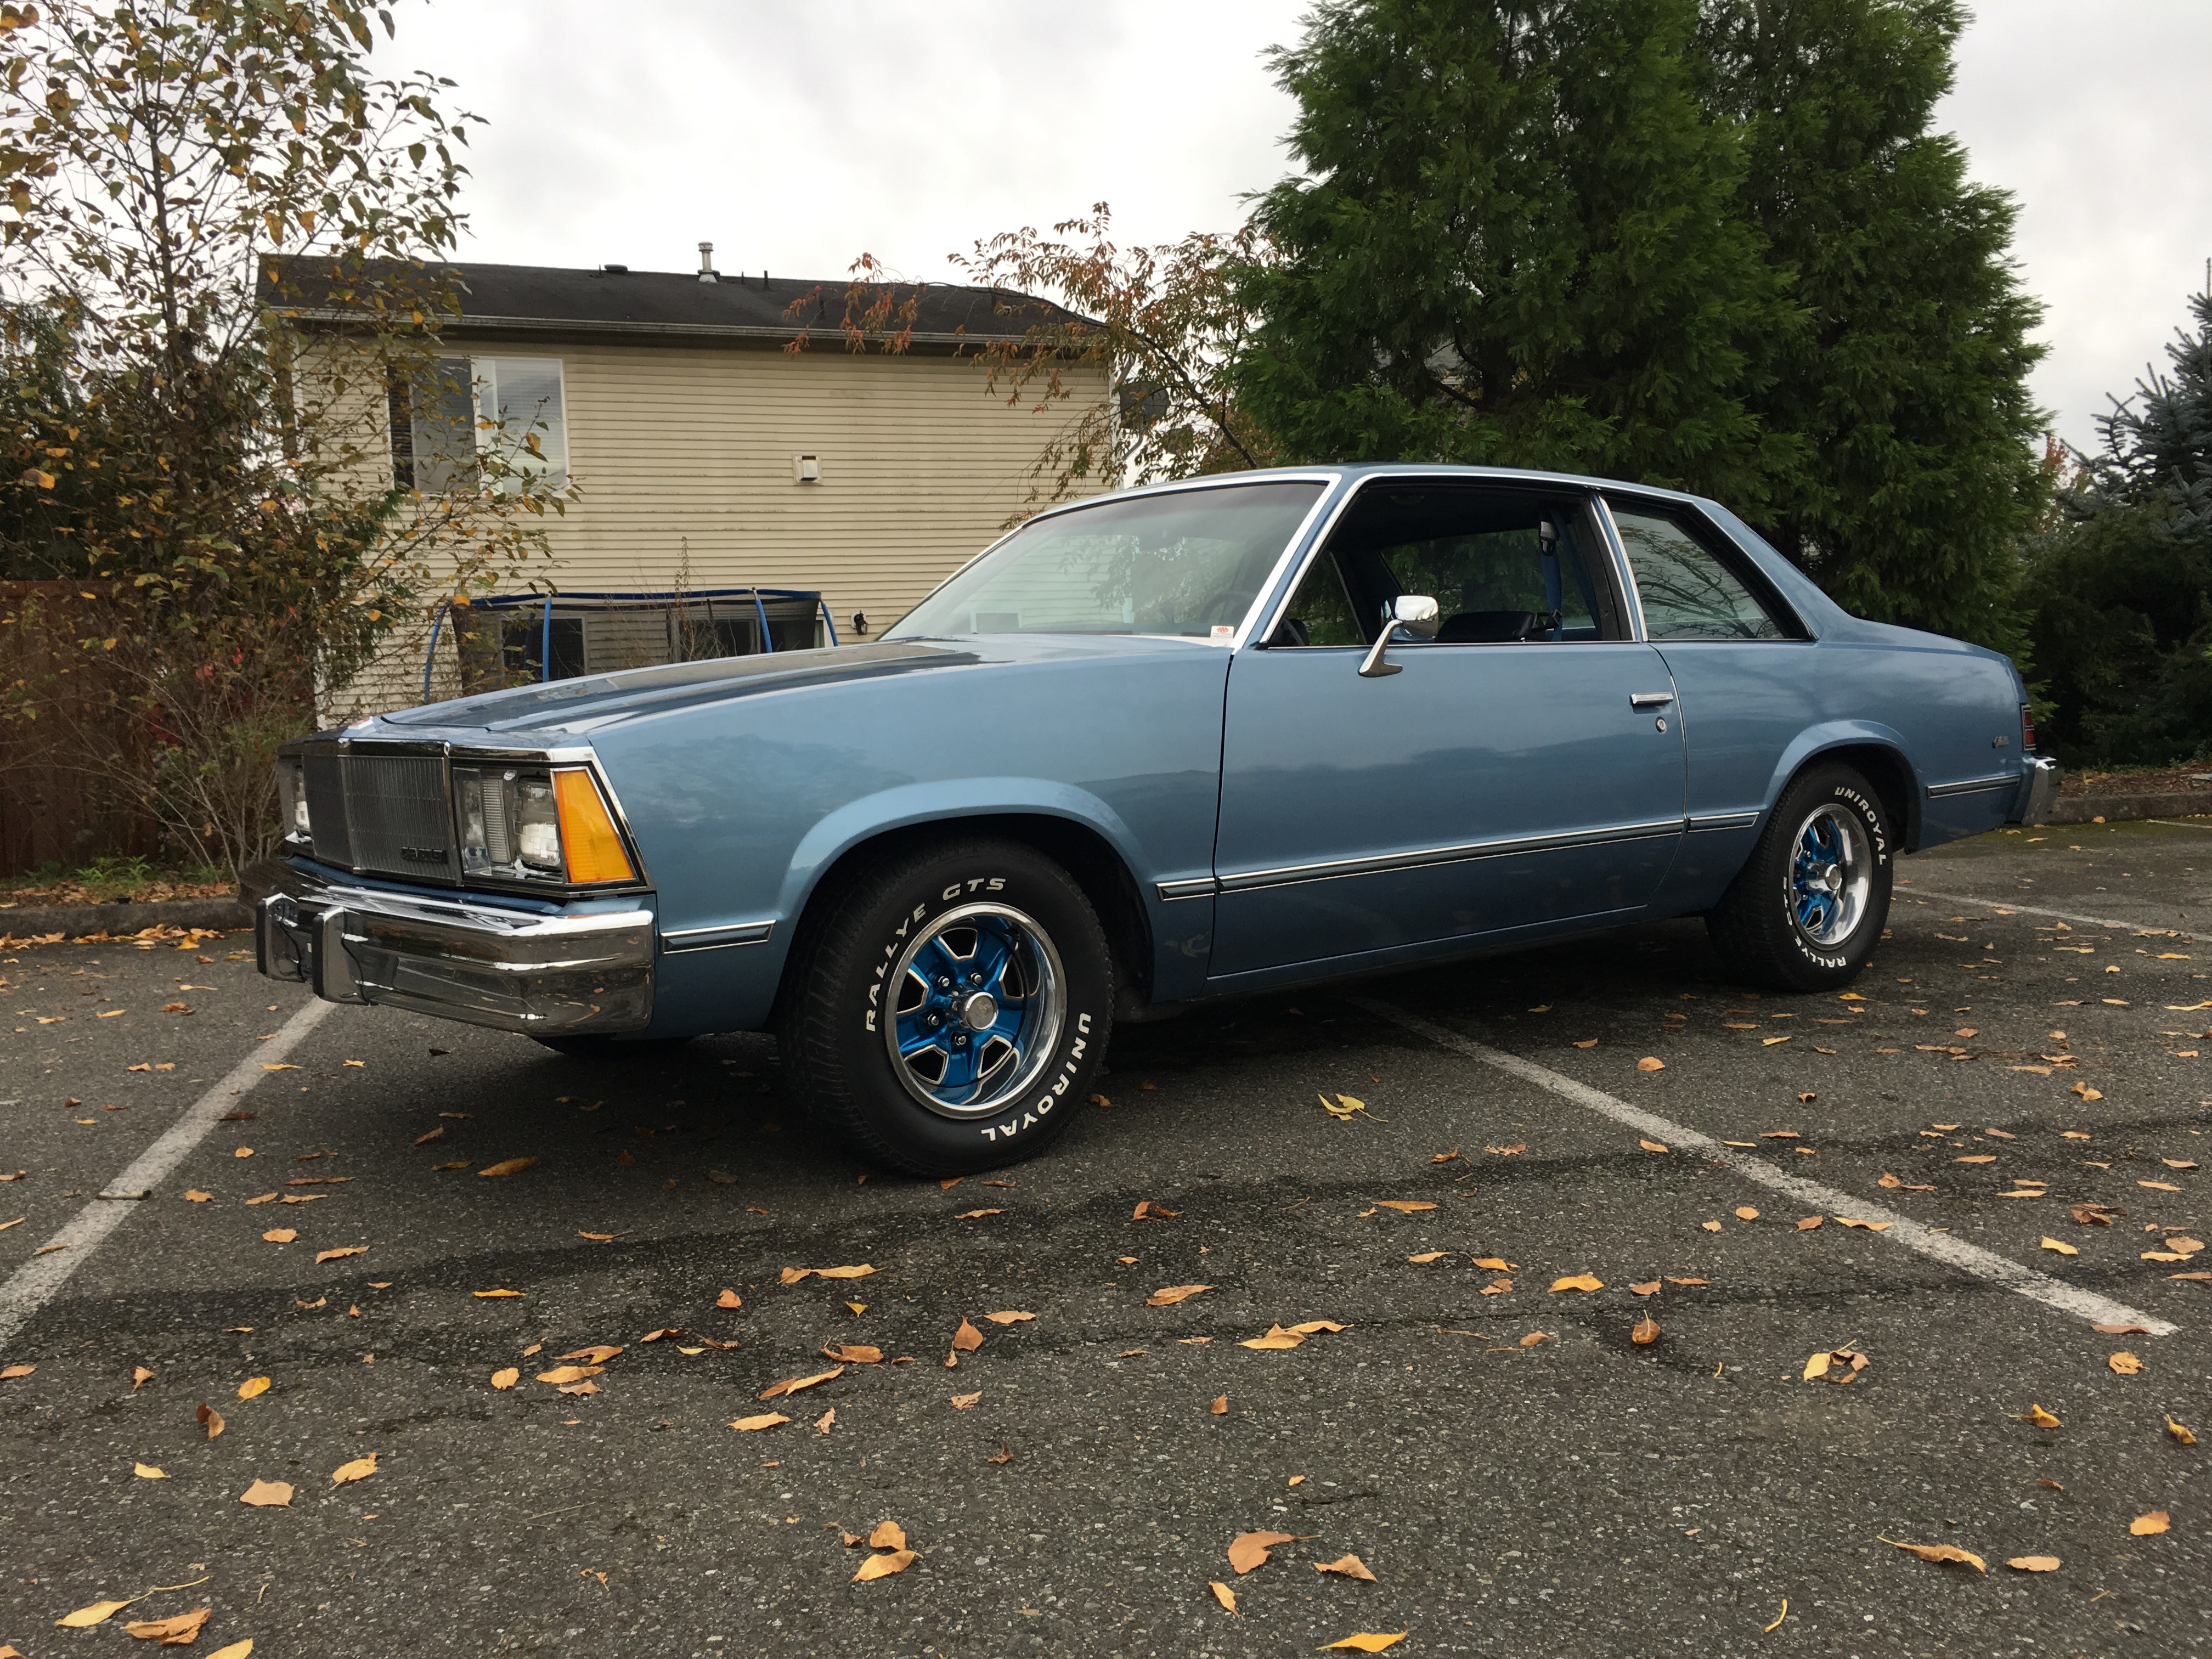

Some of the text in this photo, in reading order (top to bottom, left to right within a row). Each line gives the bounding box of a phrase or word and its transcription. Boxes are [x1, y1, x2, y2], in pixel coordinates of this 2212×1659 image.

[1835, 787, 1887, 865] UNIROYAL
[866, 878, 1007, 1032] RALLYE GTS
[1795, 936, 1847, 968] RALLYE
[981, 1013, 1091, 1141] UNIROYAL
